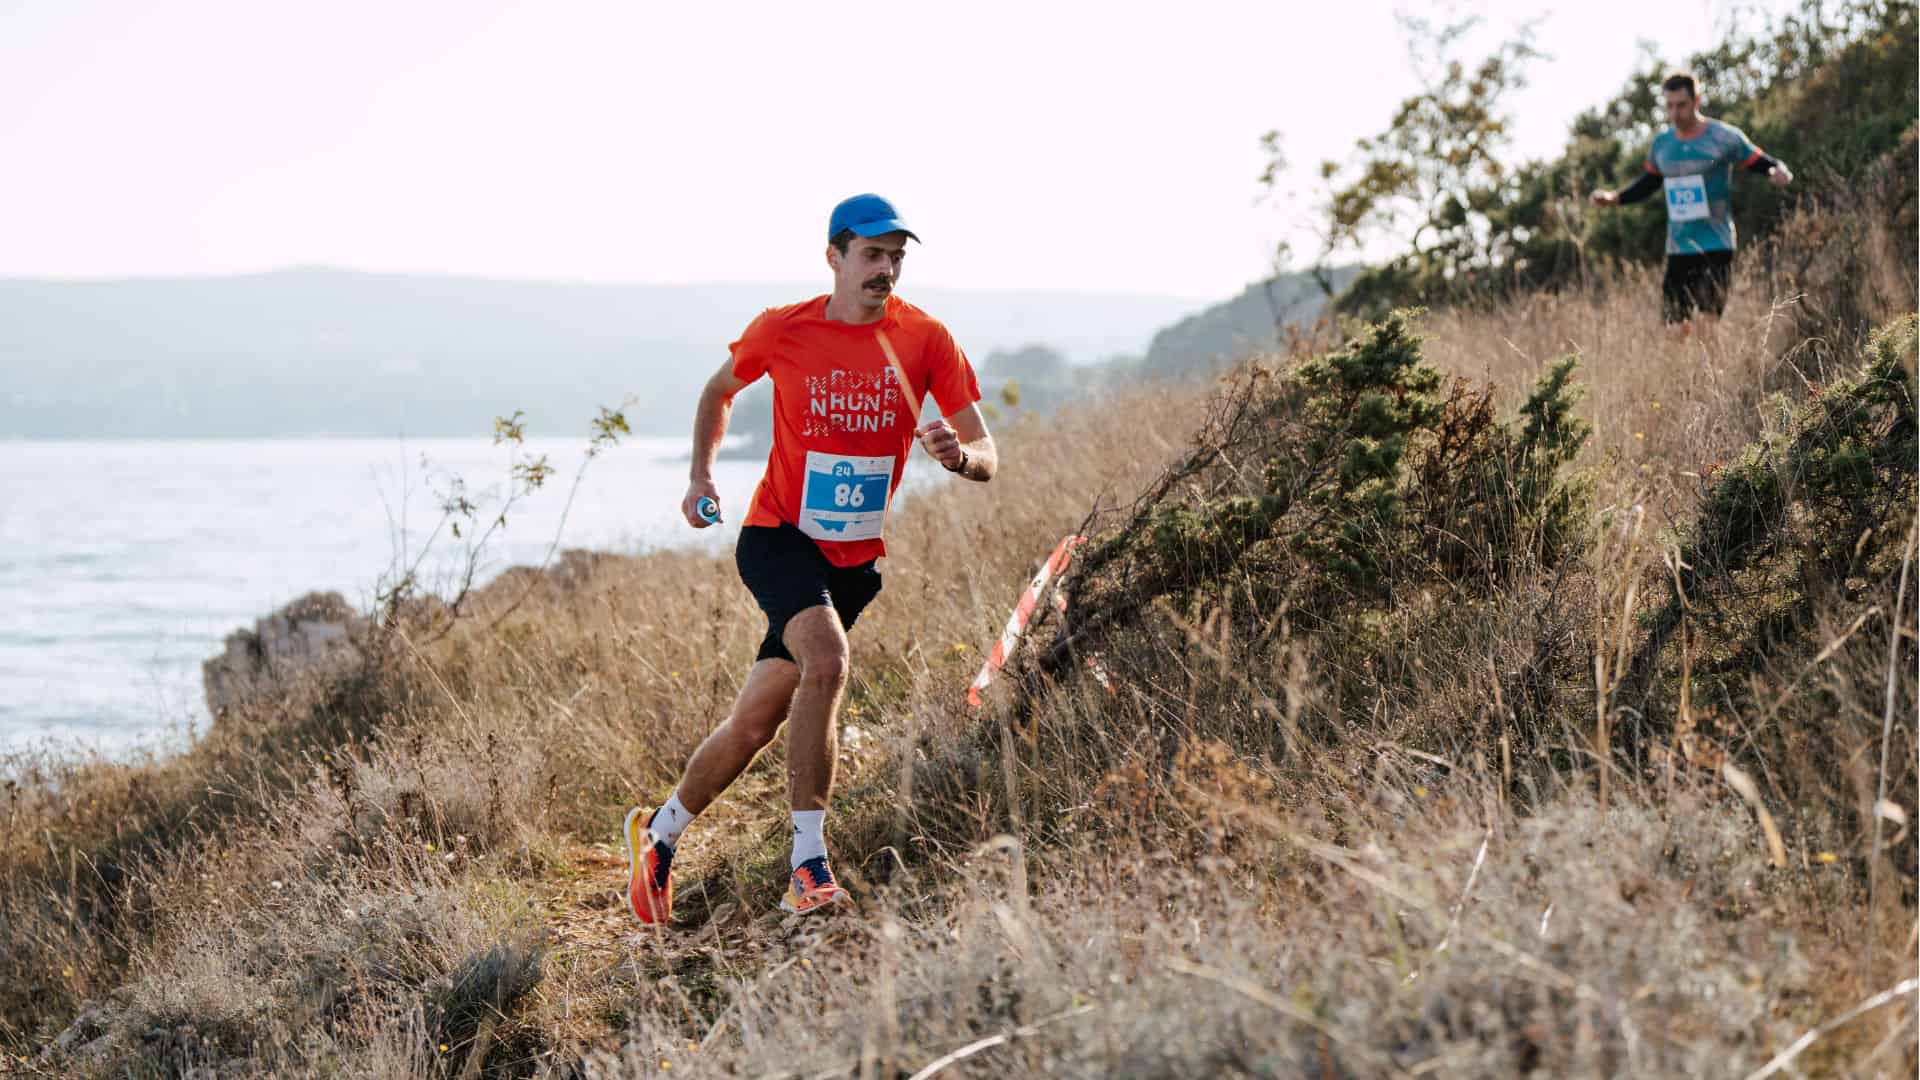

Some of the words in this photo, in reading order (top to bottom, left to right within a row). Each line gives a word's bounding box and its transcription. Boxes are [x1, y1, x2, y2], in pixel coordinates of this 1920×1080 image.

[830, 392, 881, 412] RUN
[835, 466, 851, 478] 24
[834, 483, 865, 507] 86
